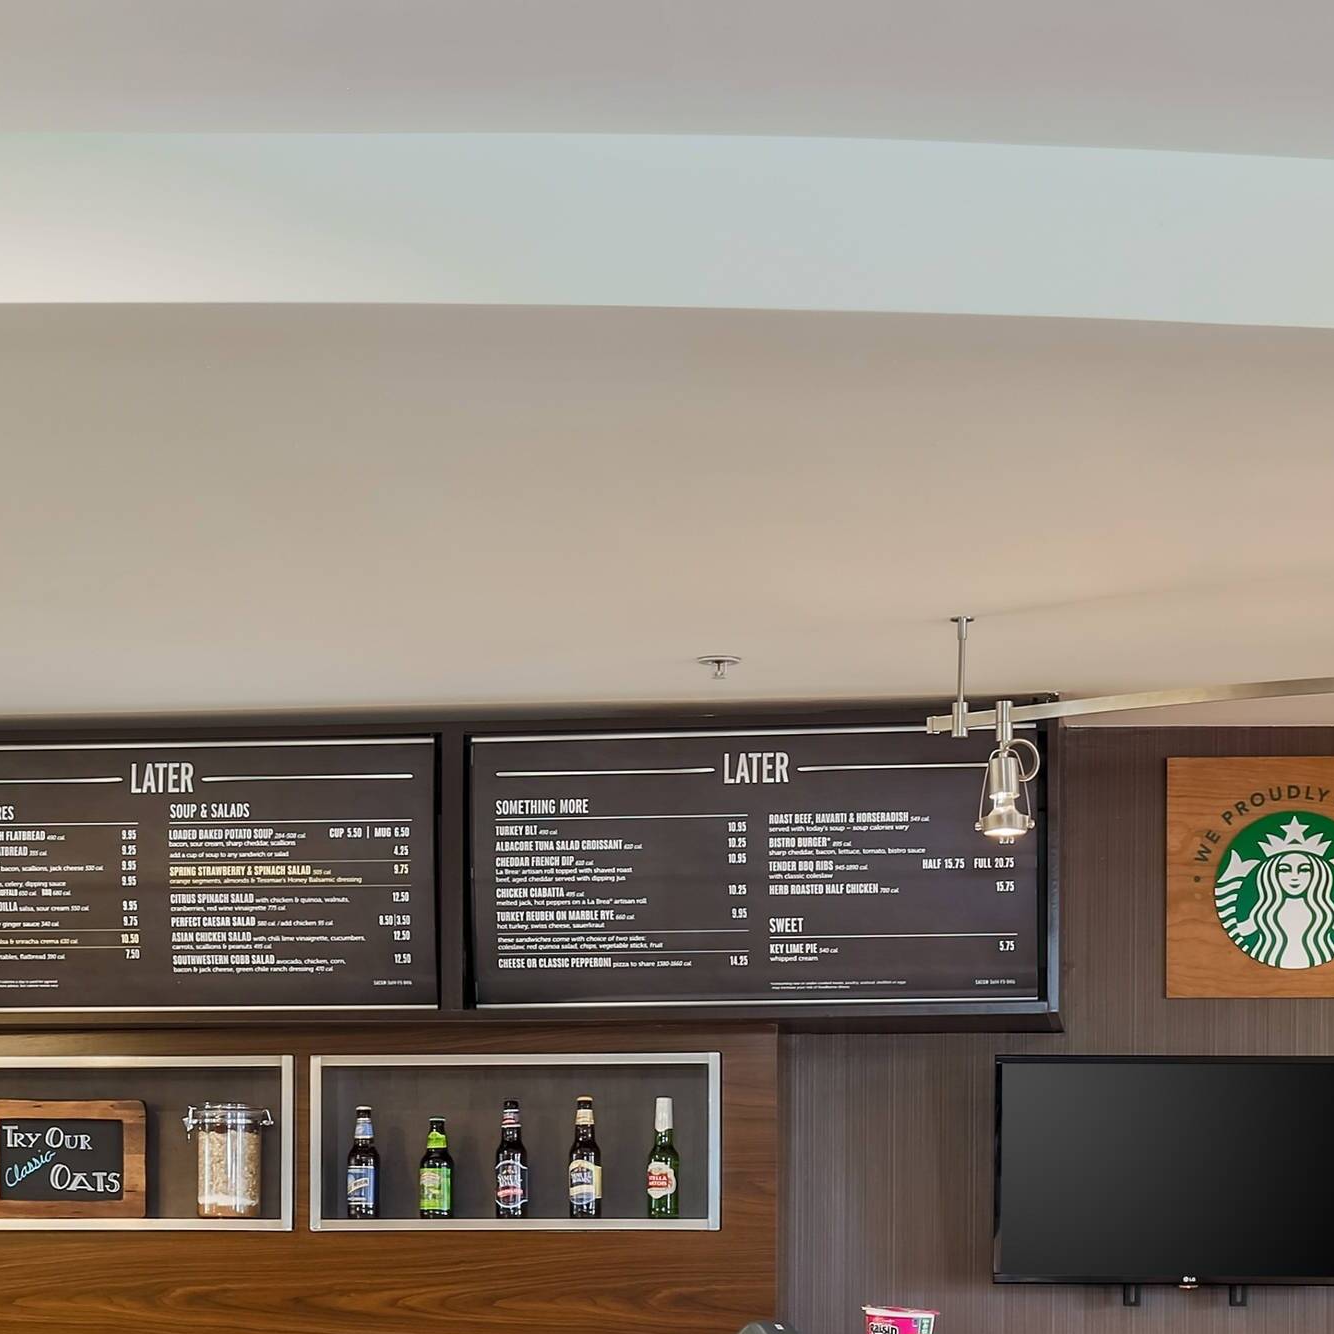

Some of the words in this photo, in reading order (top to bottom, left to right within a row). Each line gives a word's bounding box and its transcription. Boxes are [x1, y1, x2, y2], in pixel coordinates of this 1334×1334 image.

[724, 752, 788, 783] LATER
[131, 763, 193, 793] LATER
[170, 804, 197, 818] SOUP
[201, 804, 207, 818] &
[211, 803, 249, 818] SALADS
[496, 800, 555, 815] SOMETHING
[560, 799, 588, 813] MORE
[769, 814, 793, 824] ROAST
[795, 814, 813, 824] BEEF,
[816, 813, 847, 823] HAVARTI
[849, 813, 854, 823] &
[856, 812, 908, 825] HORSERADISH
[1194, 830, 1222, 863] WE
[1222, 785, 1331, 826] PROUDLY
[374, 827, 391, 837] MUG
[394, 827, 409, 837] 6.50
[496, 826, 523, 836] TURKEY
[525, 825, 537, 835] BLT
[728, 822, 746, 832] 10.95
[6, 831, 45, 840] FLATBREAD
[122, 830, 136, 839] 9.95
[169, 829, 197, 840] LOADED
[199, 829, 223, 839] BAKED
[225, 829, 252, 839] POTATO
[253, 829, 273, 839] SOUP
[330, 828, 344, 838] CUP
[347, 828, 362, 837] 5.50
[496, 841, 533, 851] ALBACORE
[535, 841, 554, 851] TUNA
[556, 840, 580, 850] SALAD
[582, 840, 622, 850] CROISSANT
[729, 837, 746, 847] 10.25
[769, 838, 795, 848] BISTRO
[122, 845, 136, 855] 9.25
[394, 846, 408, 855] 4.25
[769, 861, 796, 871] TENDER
[798, 861, 814, 872] BBQ
[816, 861, 833, 870] RIBS
[923, 859, 941, 869] HALF
[944, 858, 964, 868] 15.75
[974, 858, 991, 868] FULL
[995, 857, 1014, 868] 20.75
[170, 867, 196, 876] SPRING
[198, 866, 245, 876] STRAWBERRY
[254, 866, 285, 875] SPINACH
[287, 865, 311, 875] SALAD
[394, 864, 408, 874] 9.75
[769, 885, 789, 895] HERB
[791, 884, 823, 894] ROASTED
[826, 884, 844, 894] HALF
[846, 883, 878, 893] CHICKEN
[997, 881, 1014, 891] 15.75
[496, 888, 528, 898] CHICKEN
[530, 887, 564, 897] CIABATTA
[497, 911, 524, 921] TURKEY
[526, 911, 554, 921] REUBEN
[556, 911, 567, 920] ON
[569, 910, 598, 920] MARBLE
[600, 910, 614, 920] RYE
[171, 917, 201, 927] PERFECT
[203, 917, 230, 927] CAESAR
[232, 917, 255, 926] SALAD
[770, 918, 803, 932] SWEET
[172, 932, 194, 942] ASIAN
[193, 932, 226, 942] CHICKEN
[228, 932, 251, 941] SALAD
[394, 930, 410, 940] 12.50
[770, 944, 784, 954] KEY
[786, 944, 803, 953] LIME
[803, 943, 817, 953] PIE
[1000, 941, 1014, 951] 5.75
[499, 958, 525, 968] CHEESE
[527, 958, 537, 968] OR
[539, 958, 569, 968] CLASSIC
[571, 957, 611, 967] PEPPERONI
[730, 956, 748, 965] 14.25
